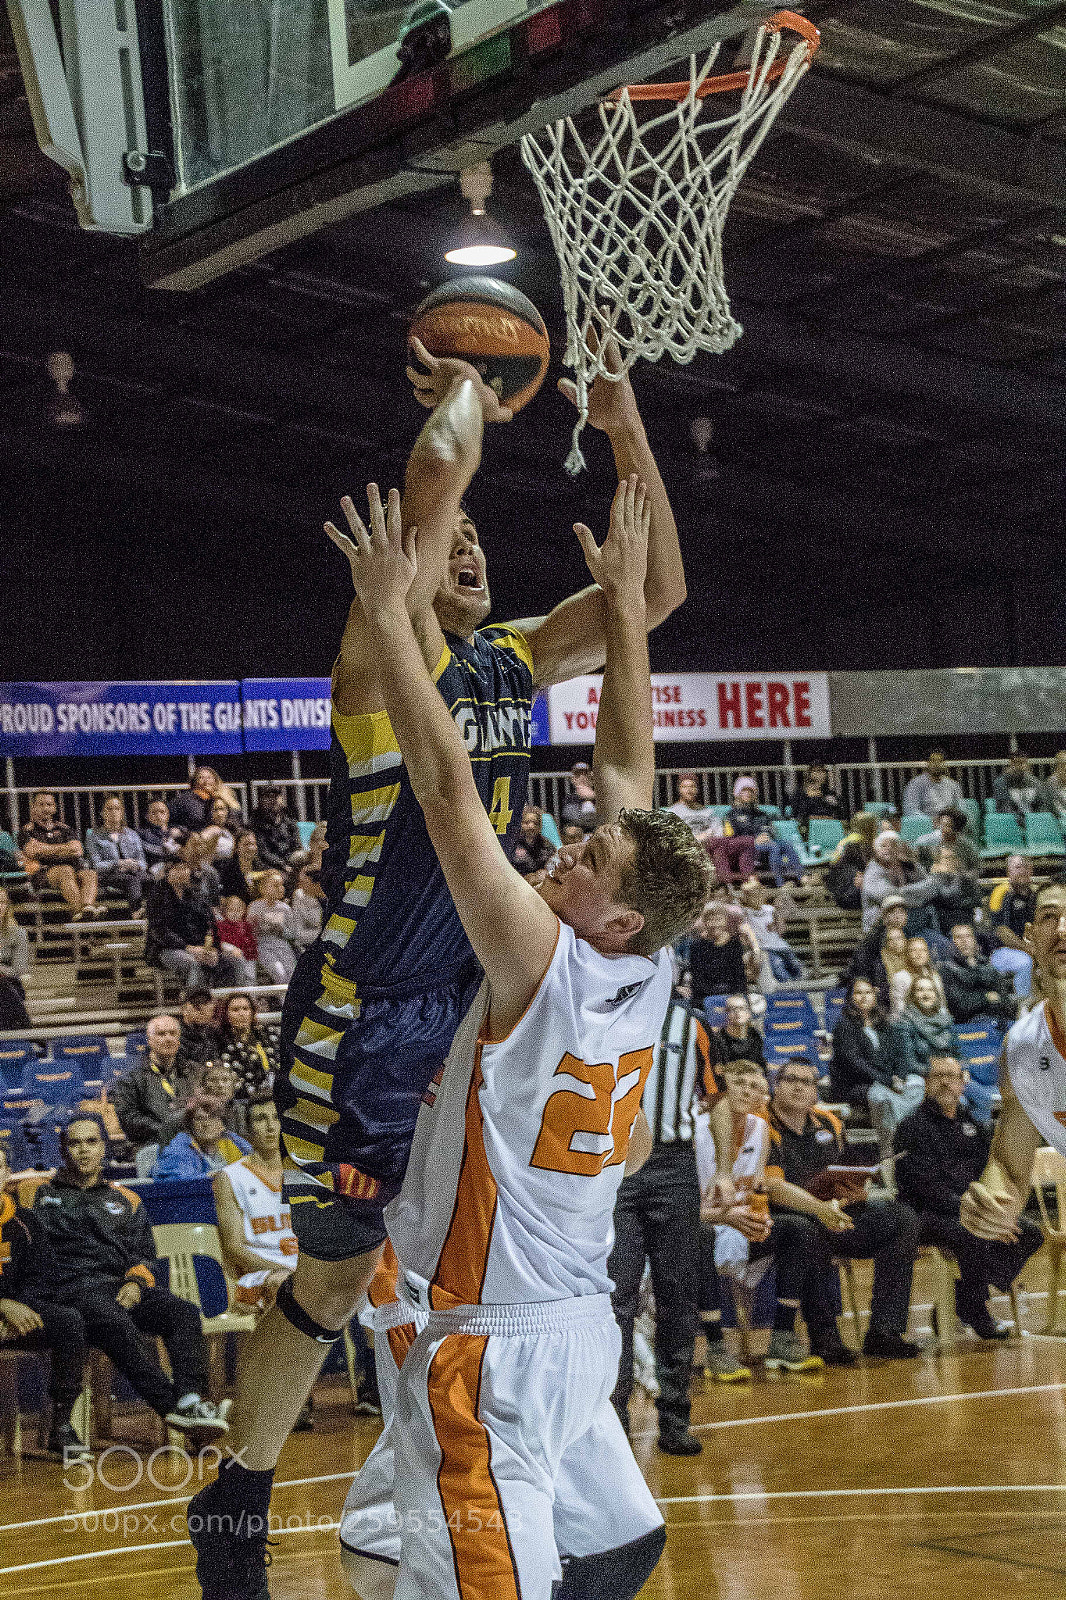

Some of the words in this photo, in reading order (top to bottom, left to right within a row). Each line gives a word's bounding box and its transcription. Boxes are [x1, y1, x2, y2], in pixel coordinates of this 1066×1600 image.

[0, 703, 54, 732] ROUD
[56, 702, 151, 732] SPONSORS
[153, 702, 177, 731] OF
[178, 702, 213, 731] THE
[214, 699, 280, 731] GIANTS
[717, 681, 811, 728] HERE
